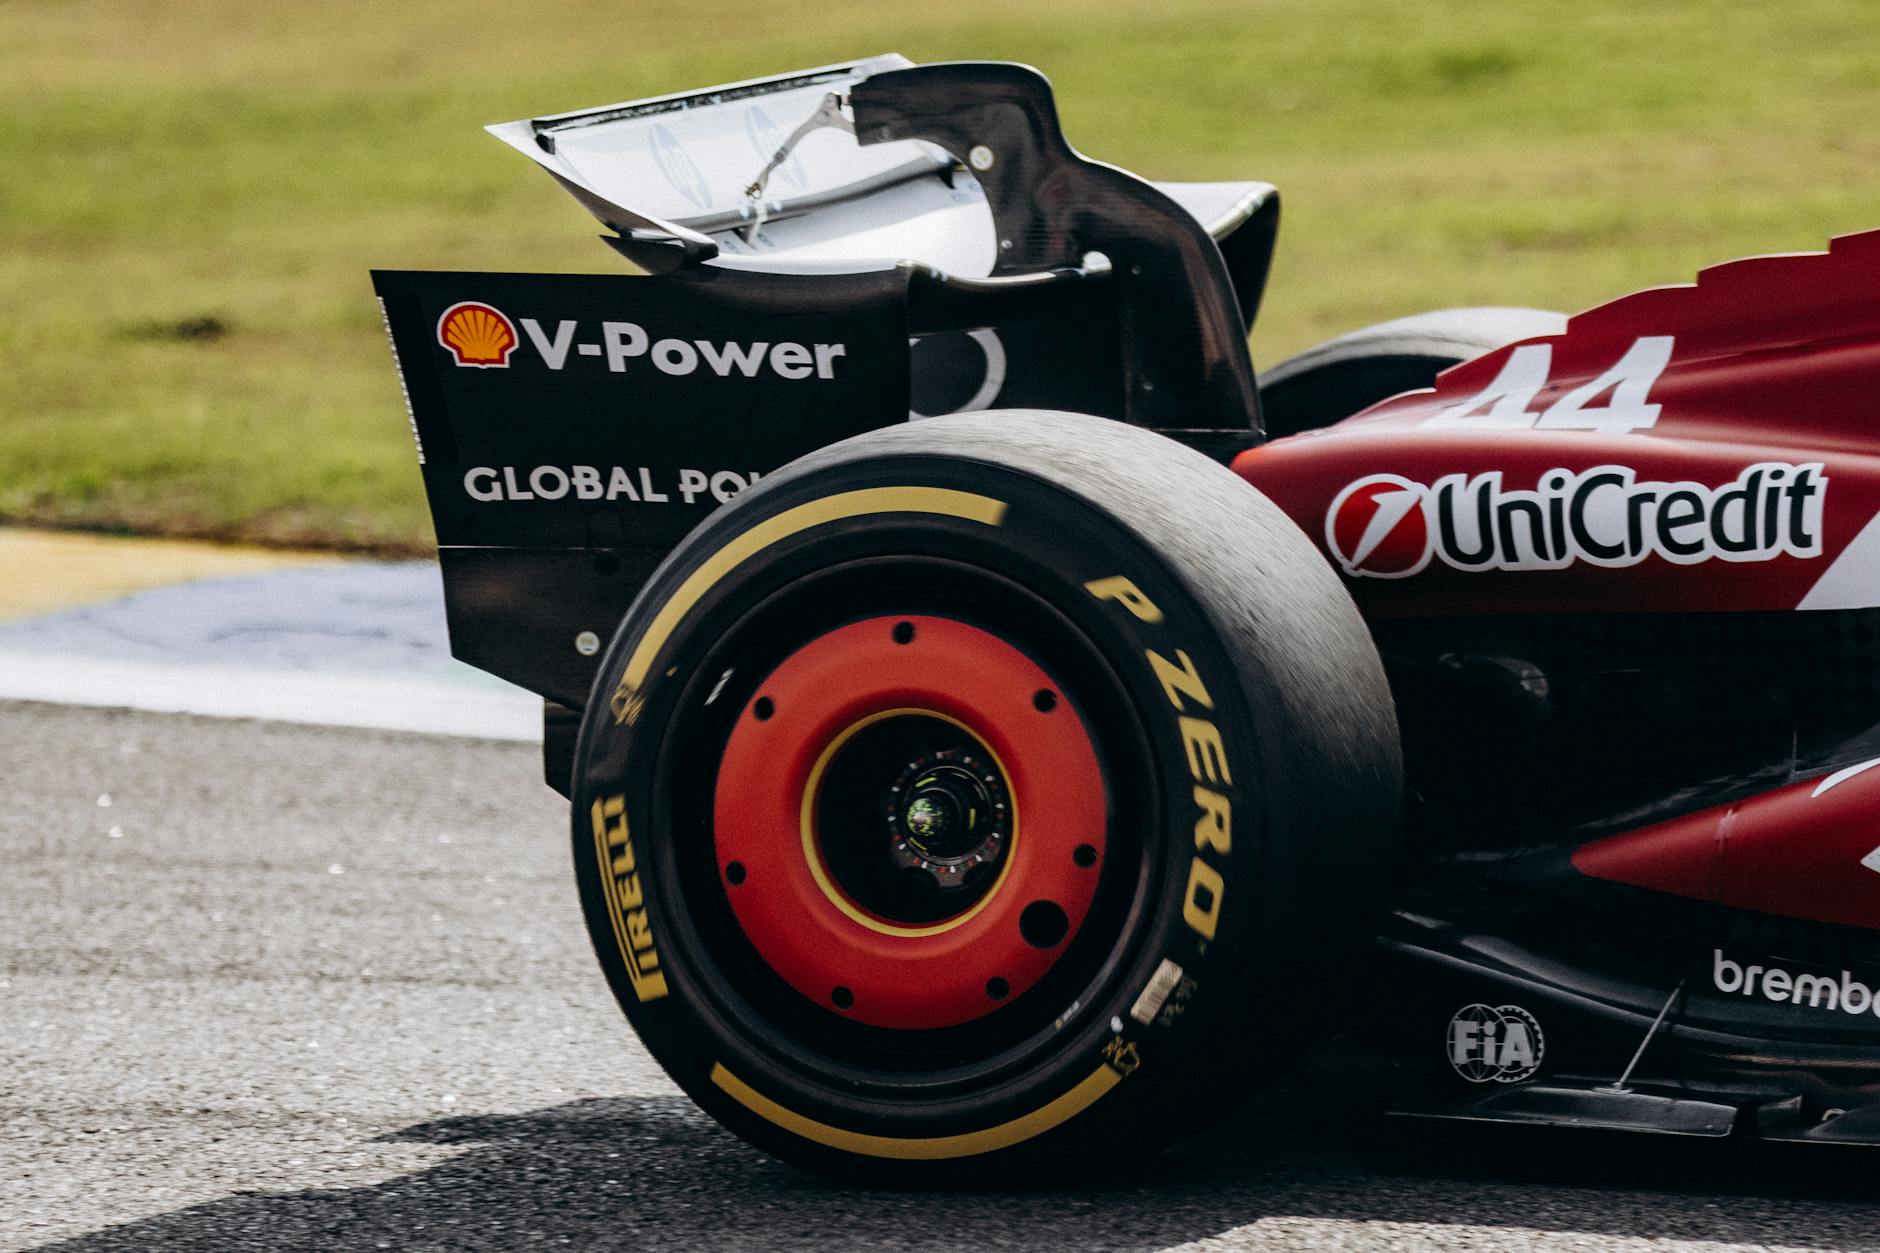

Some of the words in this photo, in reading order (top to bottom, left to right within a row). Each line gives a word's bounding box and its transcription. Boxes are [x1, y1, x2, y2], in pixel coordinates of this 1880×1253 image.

[519, 318, 846, 379] V-Power
[1422, 336, 1675, 434] 44
[464, 466, 669, 503] GLOBAL
[1438, 467, 1817, 565] UniCredit
[1083, 575, 1164, 623] P
[1145, 648, 1232, 941] ZERO
[591, 793, 669, 1002] PIRELLI
[1713, 948, 1880, 1018] bremb
